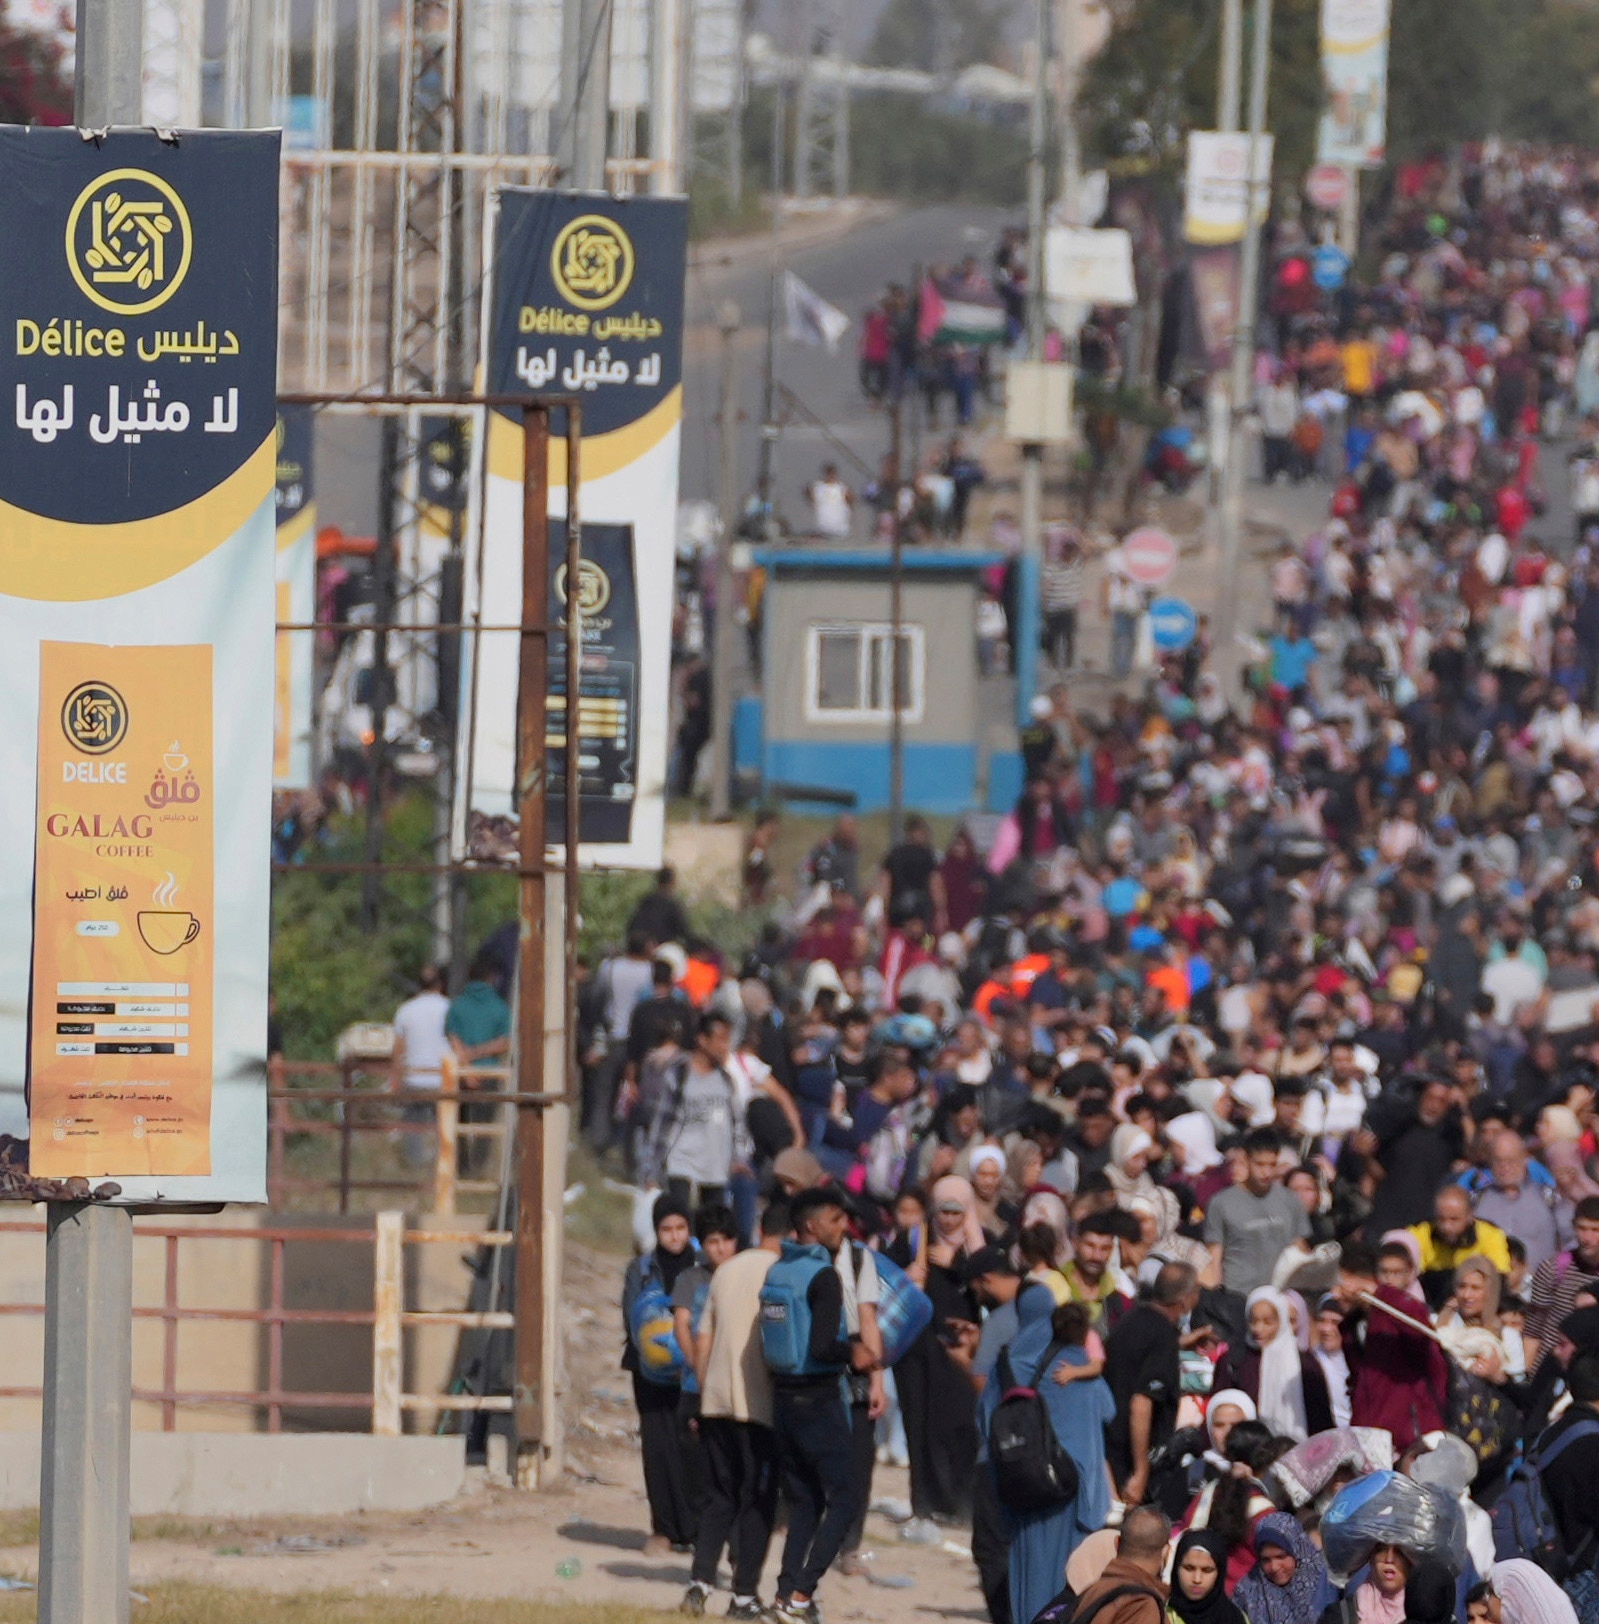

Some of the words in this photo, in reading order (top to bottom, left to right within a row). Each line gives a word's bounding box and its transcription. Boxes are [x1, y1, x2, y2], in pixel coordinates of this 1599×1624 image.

[16, 317, 126, 357] Délice
[519, 305, 591, 336] Délice
[592, 311, 663, 342] ديليس
[137, 320, 240, 364] ديليس
[516, 346, 557, 388] لها
[562, 346, 630, 391] مثيل
[634, 352, 662, 386] لا
[15, 383, 74, 443] لها
[89, 379, 191, 444] مثيل
[204, 387, 239, 433] لا
[62, 760, 129, 785] DELICE
[46, 813, 154, 839] GALAG
[96, 844, 154, 858] COFFEE
